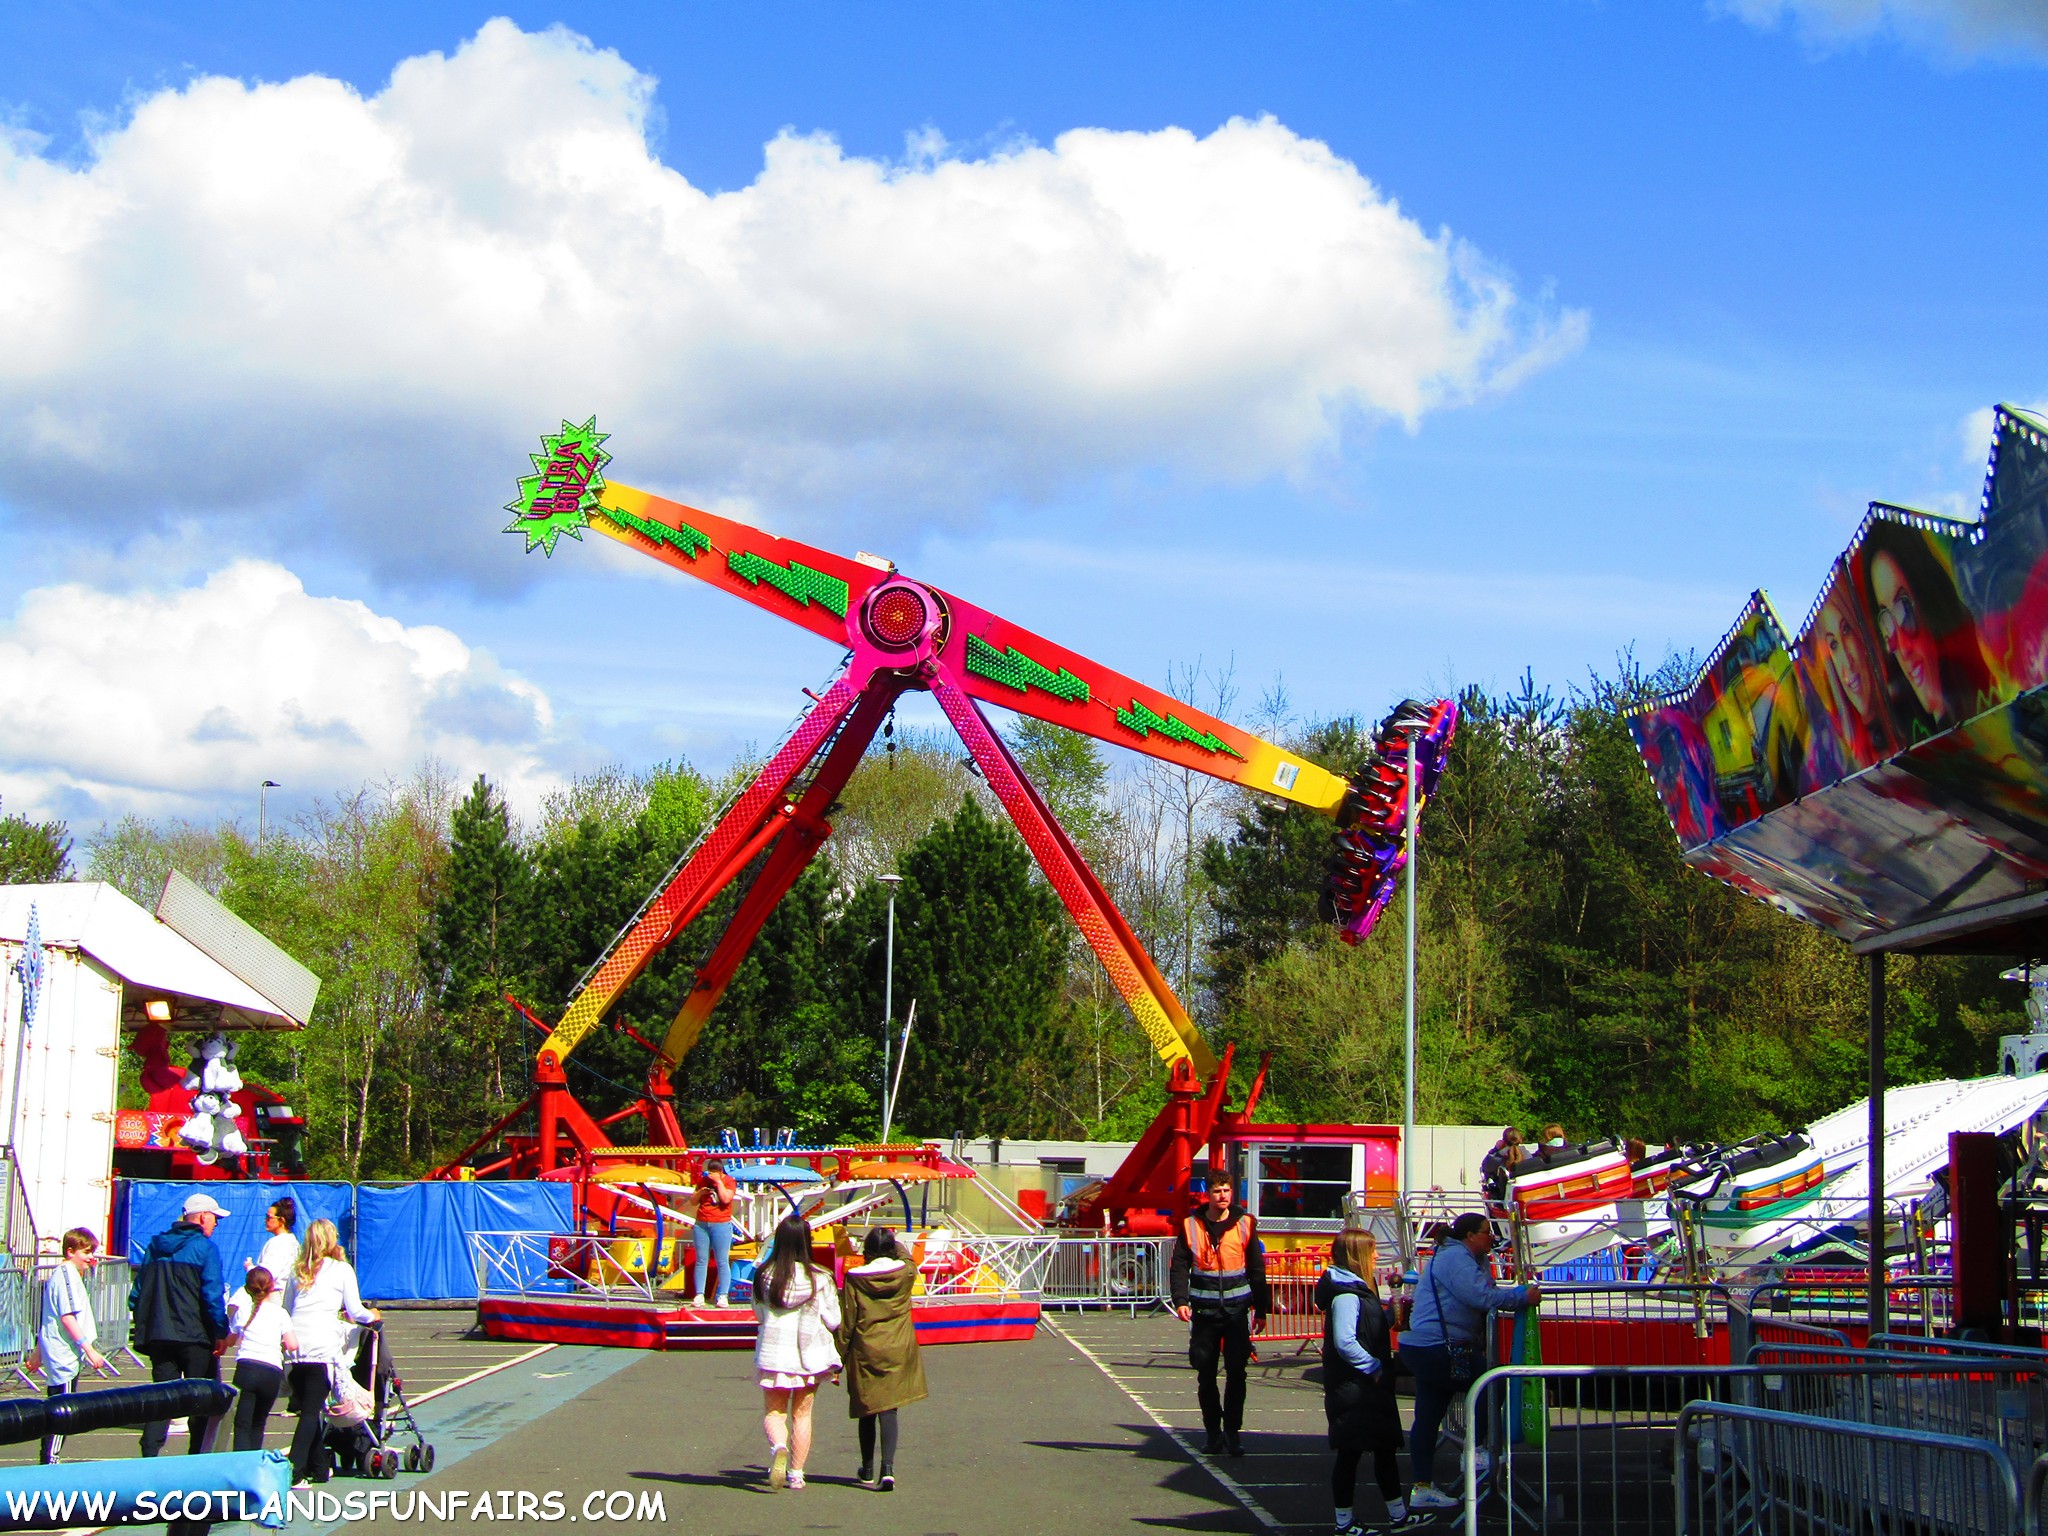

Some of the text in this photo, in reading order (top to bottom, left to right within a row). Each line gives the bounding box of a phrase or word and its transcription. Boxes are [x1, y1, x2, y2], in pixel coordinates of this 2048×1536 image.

[525, 441, 582, 520] ULTRA
[552, 453, 600, 513] BUZZ
[119, 1130, 147, 1140] TOWN
[124, 1120, 142, 1130] TOY
